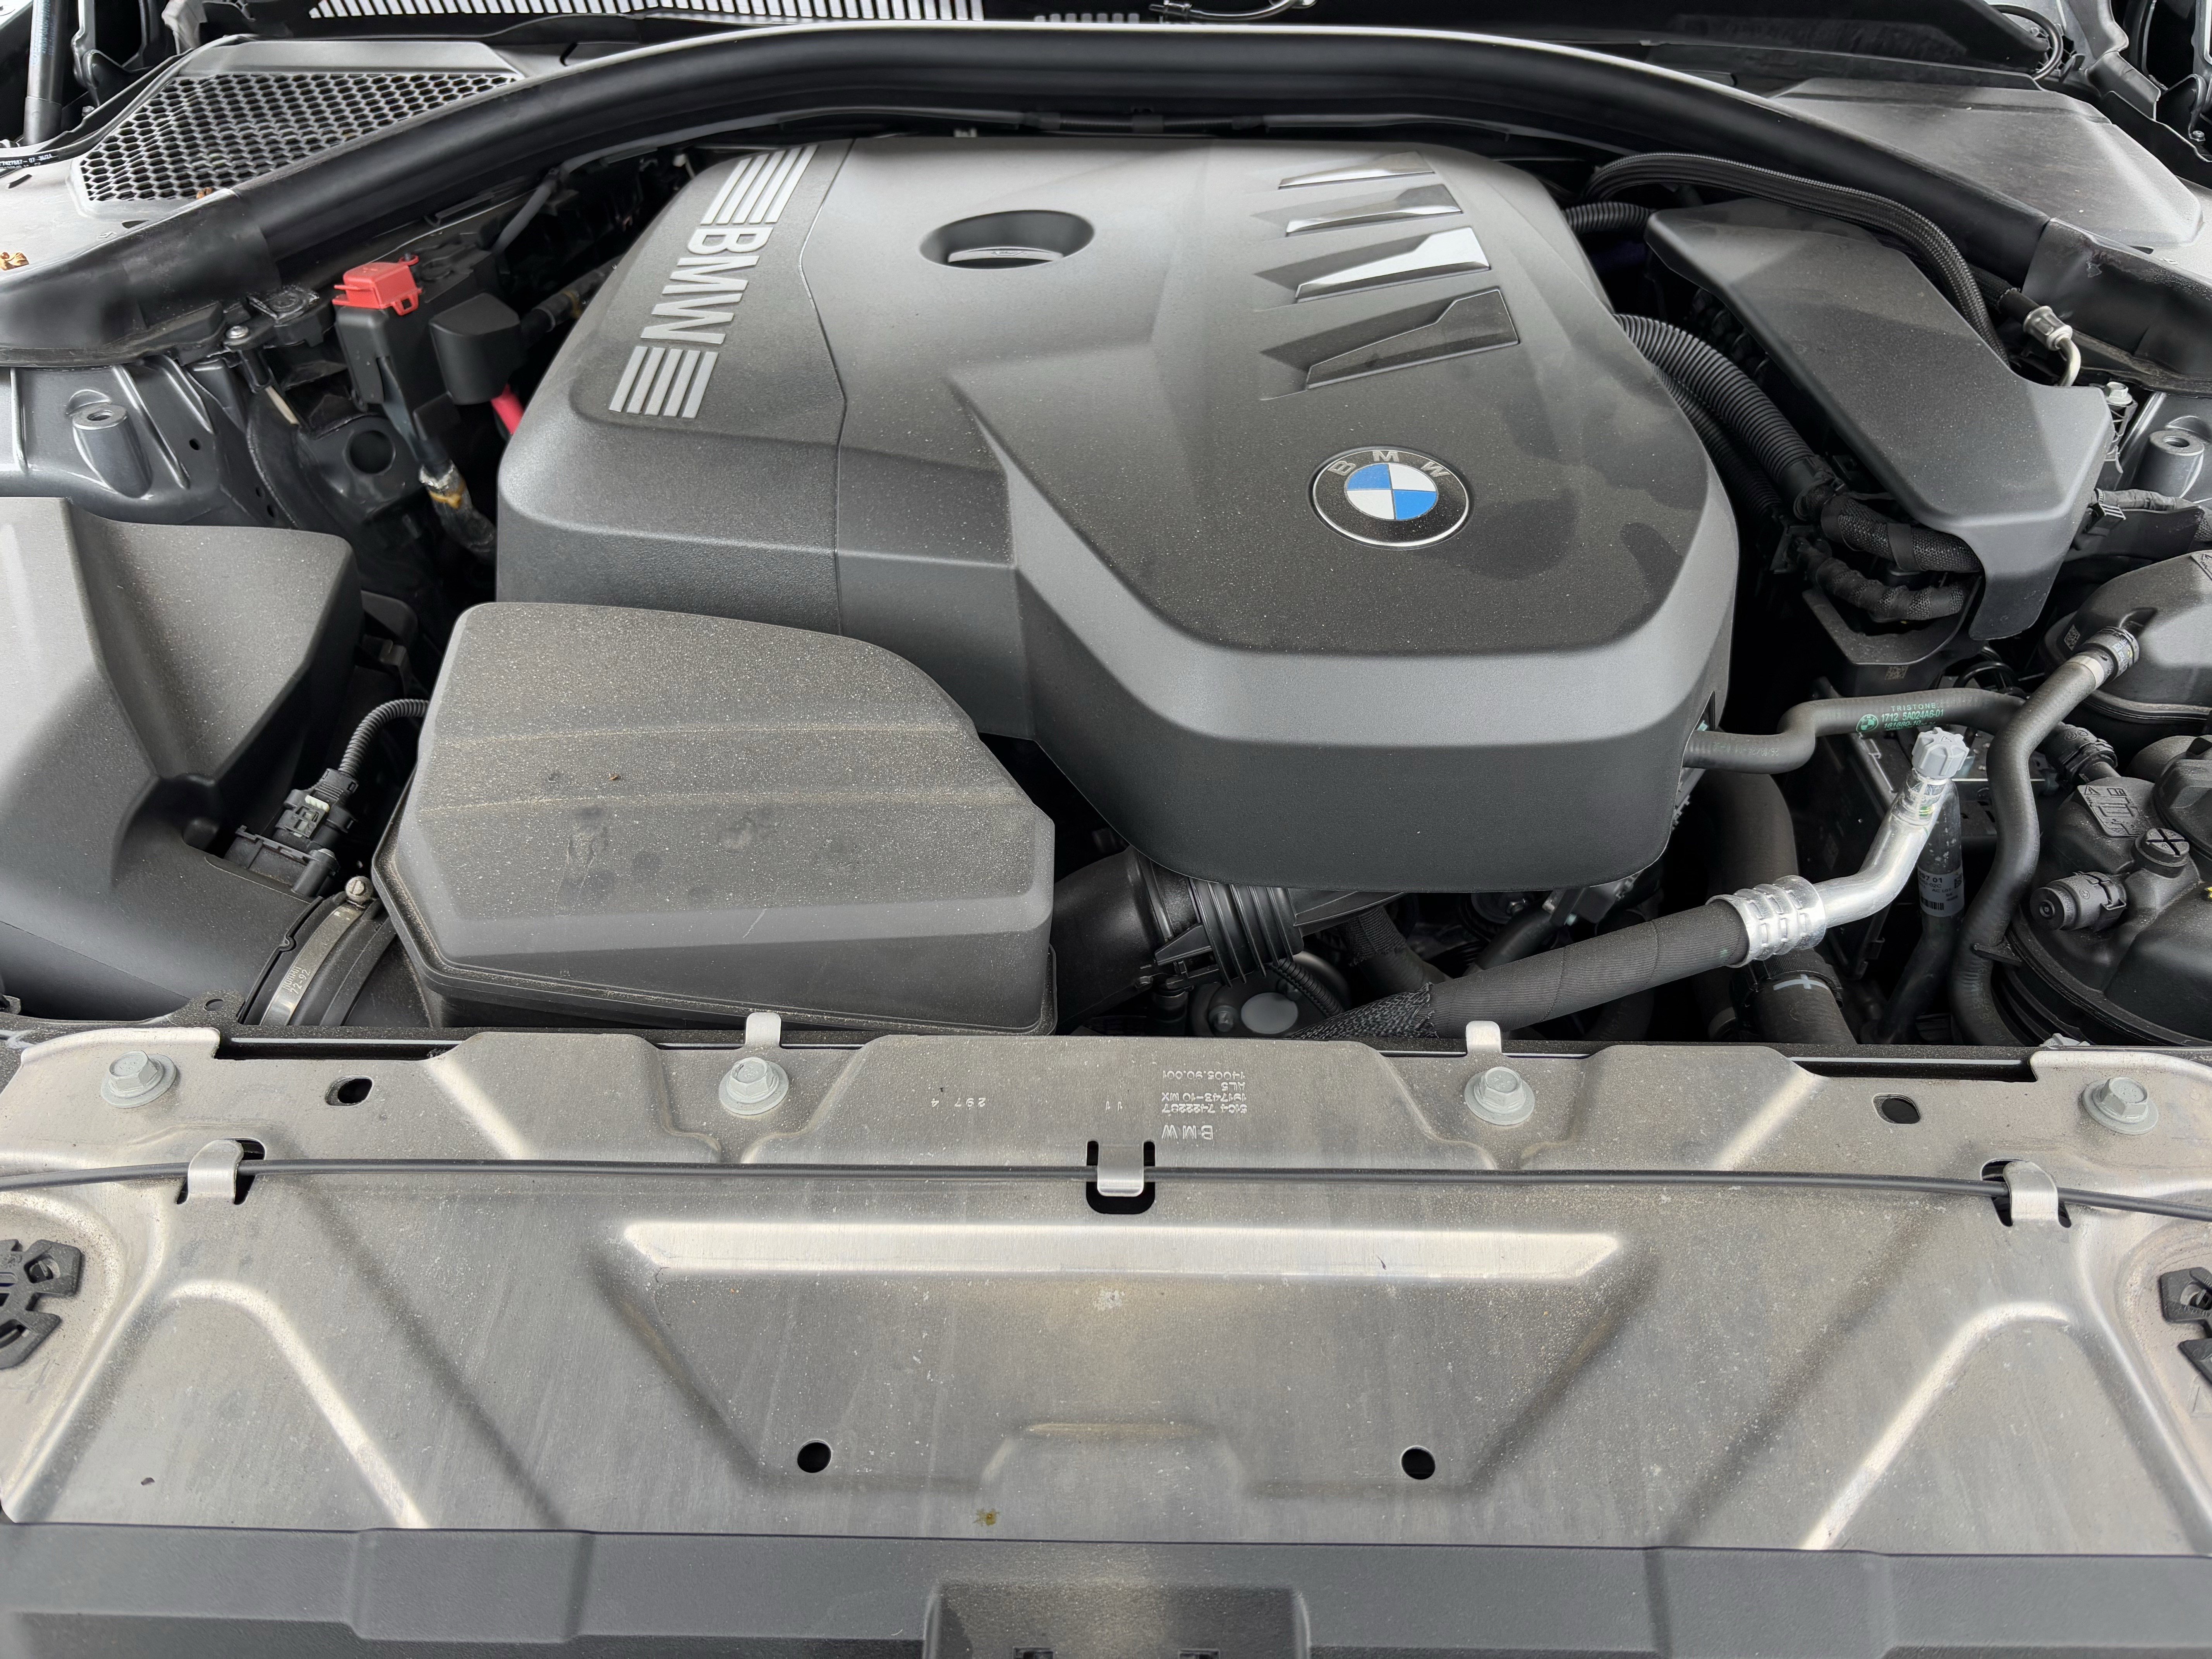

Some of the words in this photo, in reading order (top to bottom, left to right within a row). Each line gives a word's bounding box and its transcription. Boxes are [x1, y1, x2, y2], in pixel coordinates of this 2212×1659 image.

[640, 227, 773, 344] BMW
[1328, 451, 1450, 477] BMW
[1891, 702, 1936, 712] TRISTONE
[1881, 713, 1899, 722] 1712
[1902, 709, 1944, 721] 5A024A6-01
[289, 969, 311, 994] 72-92
[1163, 1070, 1245, 1080] 14005.90.001
[1221, 1082, 1246, 1091] AL5
[955, 1097, 986, 1108] 297
[1162, 1092, 1180, 1102] MX
[1182, 1092, 1247, 1102] 191743-10
[931, 1098, 940, 1108] 4
[1162, 1103, 1216, 1114] 7422287
[1162, 1125, 1213, 1140] BMW
